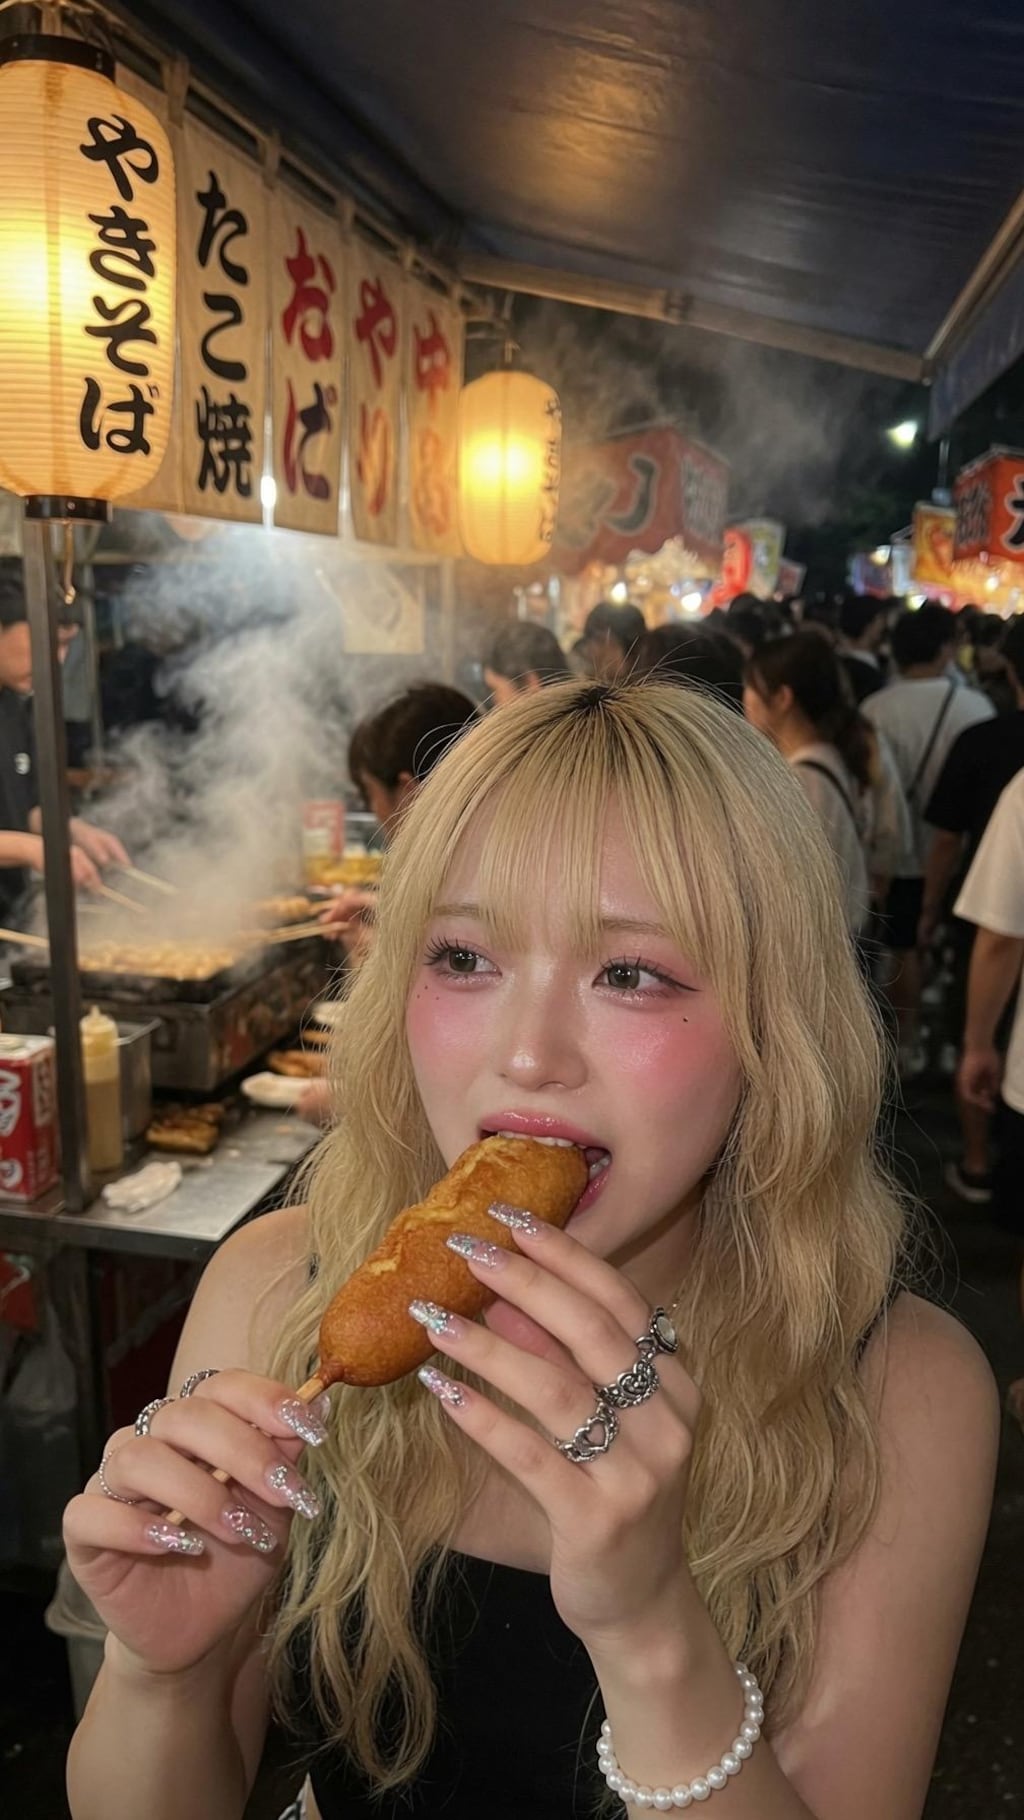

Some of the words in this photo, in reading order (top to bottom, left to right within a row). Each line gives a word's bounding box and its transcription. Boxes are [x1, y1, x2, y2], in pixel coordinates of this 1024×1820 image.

[79, 113, 160, 457] やきそば
[195, 169, 252, 498] たこ焼
